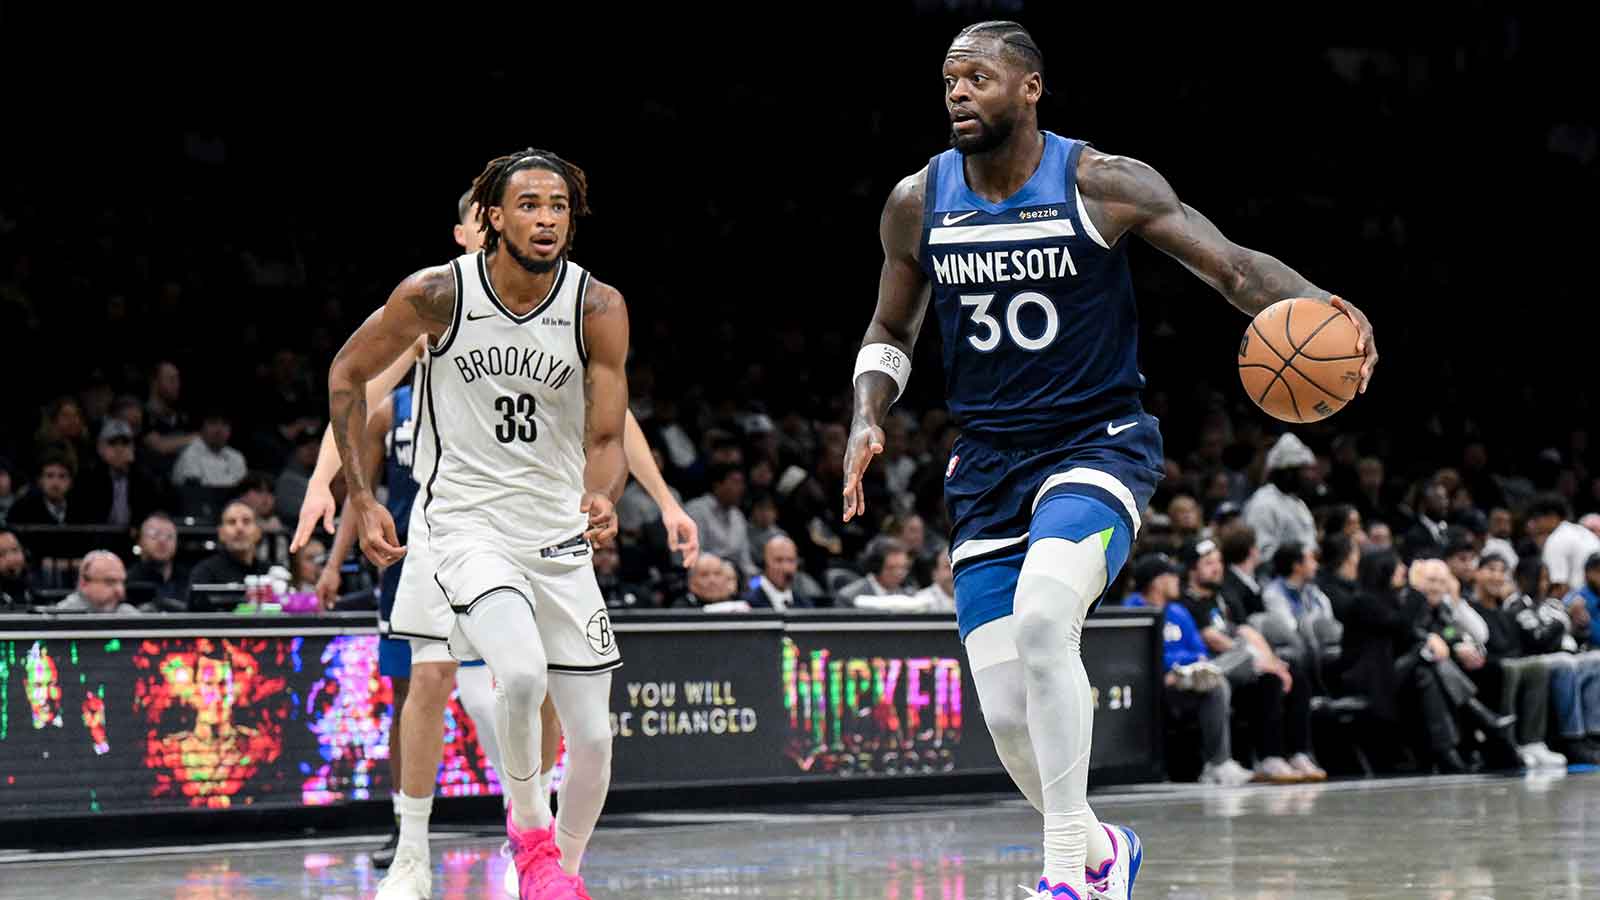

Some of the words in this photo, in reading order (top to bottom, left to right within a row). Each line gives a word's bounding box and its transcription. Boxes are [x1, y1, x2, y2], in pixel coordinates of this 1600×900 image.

[1026, 207, 1059, 219] sezzle
[932, 246, 1078, 284] MINNESOTA
[960, 292, 1058, 351] 30
[454, 346, 575, 390] BROOKLYN
[881, 351, 901, 369] 30
[494, 393, 538, 443] 33
[627, 682, 677, 707] YOU
[684, 681, 737, 706] WILL
[1109, 685, 1132, 710] 21
[641, 707, 758, 737] CHANGED
